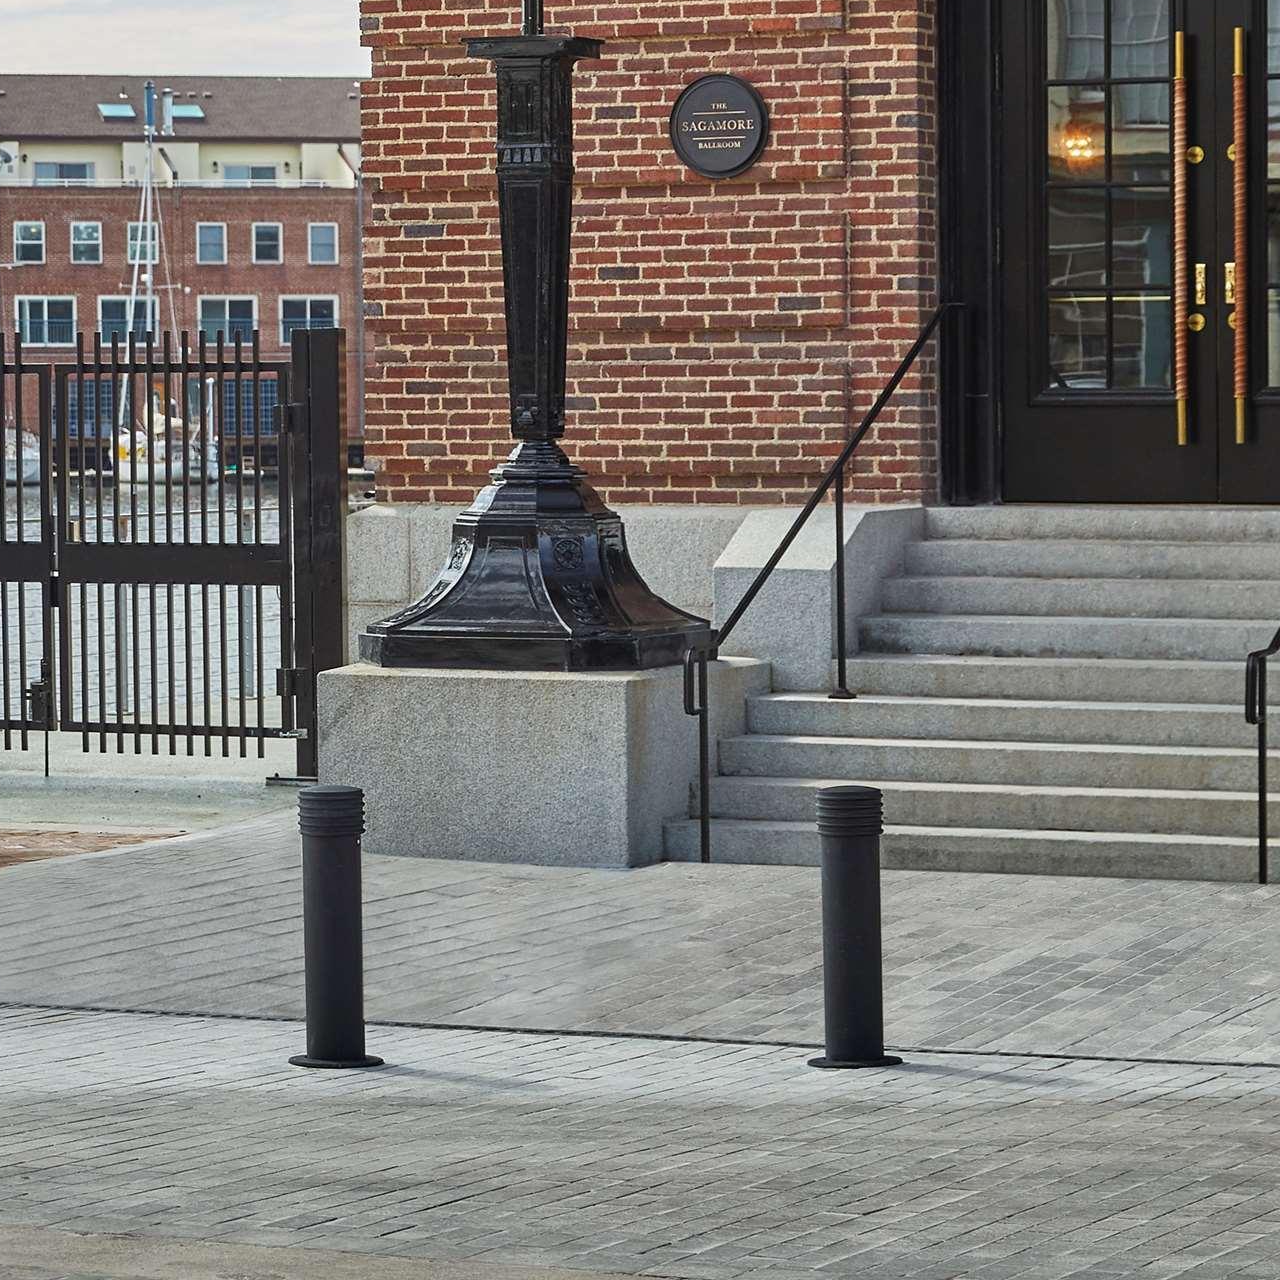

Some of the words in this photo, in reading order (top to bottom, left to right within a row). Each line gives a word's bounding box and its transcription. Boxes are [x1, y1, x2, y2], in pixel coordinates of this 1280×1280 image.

[711, 102, 728, 110] THE
[682, 119, 754, 132] SAGAMORE
[698, 141, 741, 149] BALLROOM
